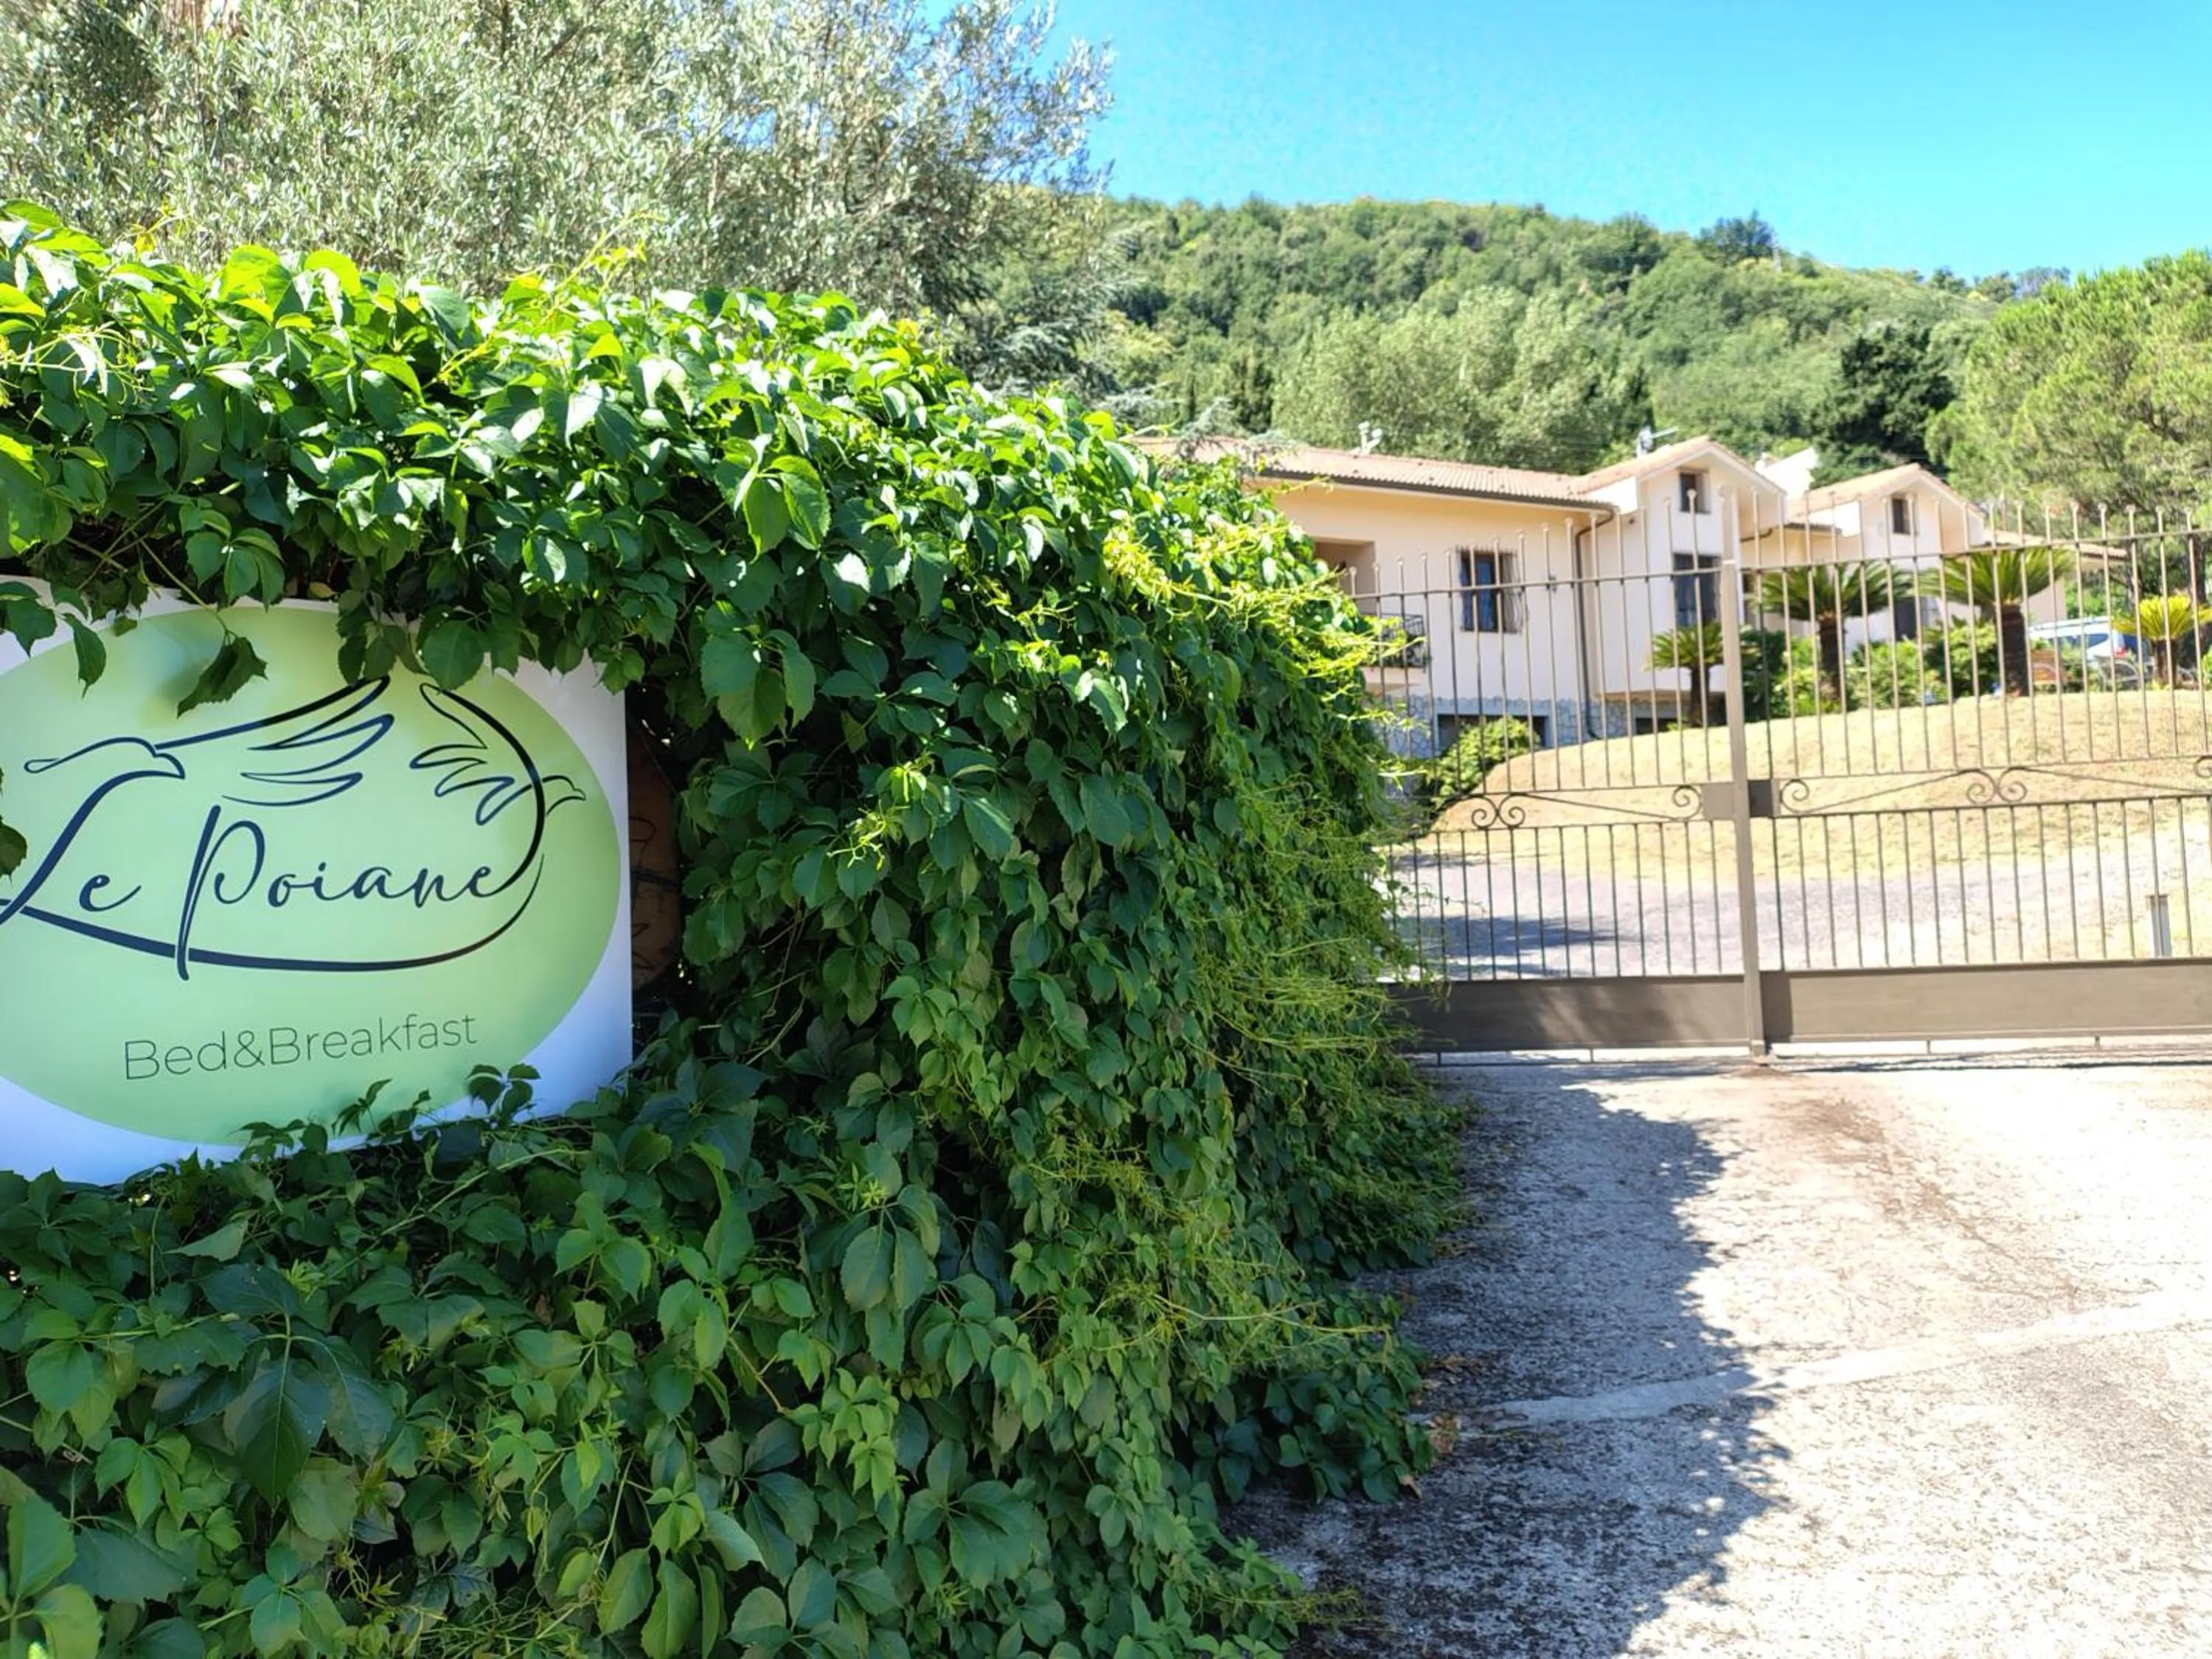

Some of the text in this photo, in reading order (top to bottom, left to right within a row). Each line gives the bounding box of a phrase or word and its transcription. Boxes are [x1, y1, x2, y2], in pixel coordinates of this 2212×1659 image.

[0, 772, 498, 981] Le Poiane
[125, 1014, 479, 1080] Bed&Breakfast
